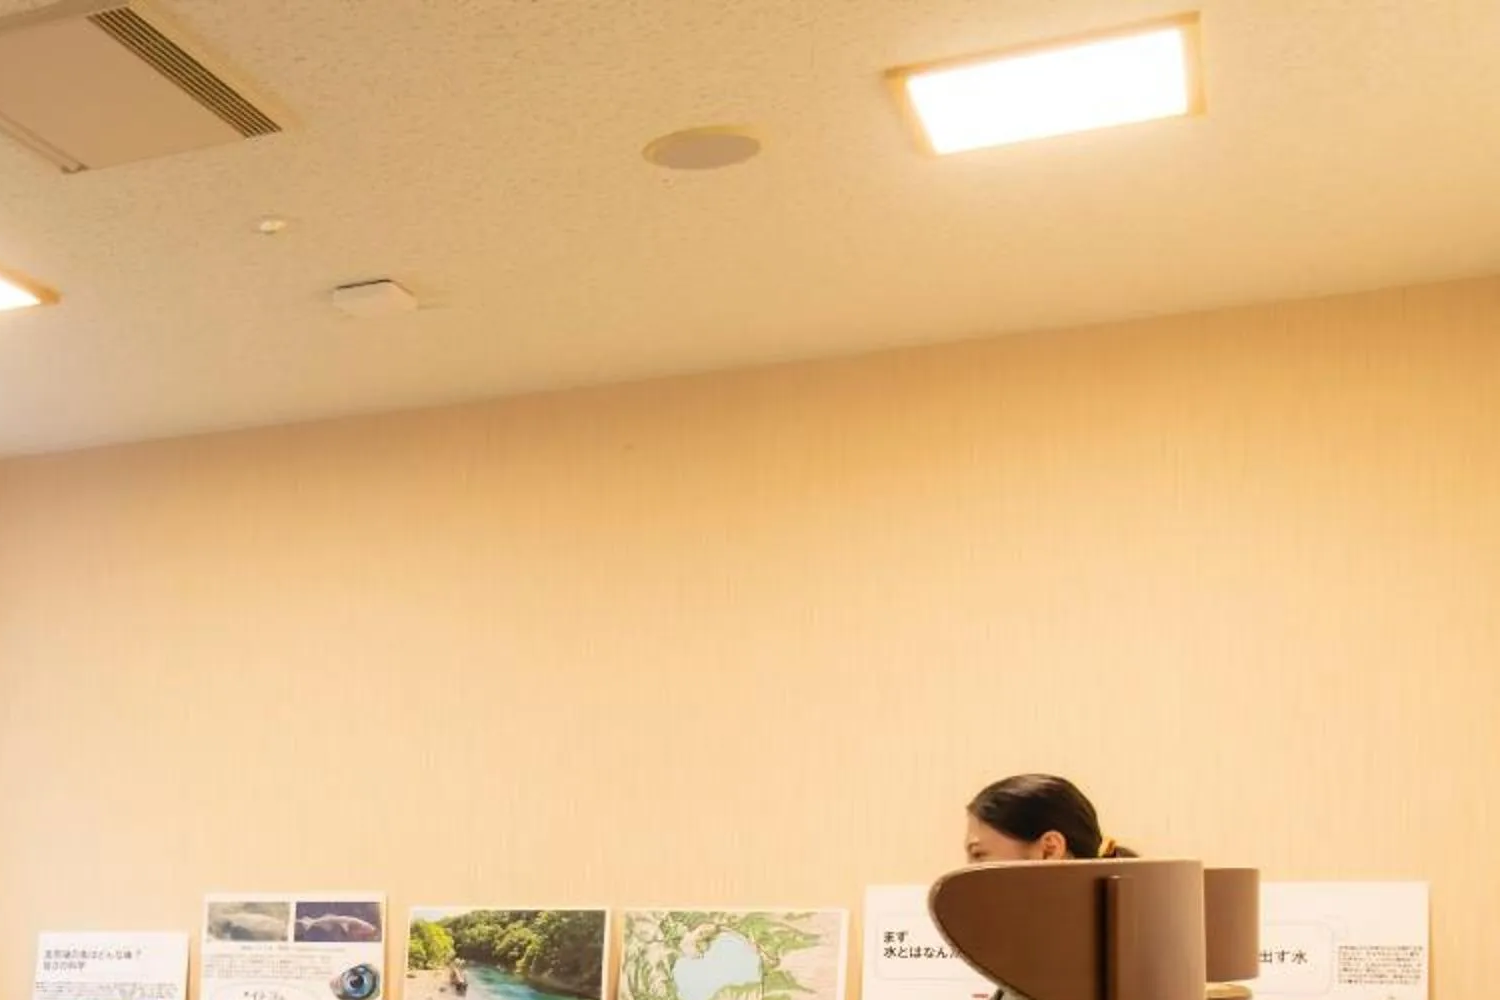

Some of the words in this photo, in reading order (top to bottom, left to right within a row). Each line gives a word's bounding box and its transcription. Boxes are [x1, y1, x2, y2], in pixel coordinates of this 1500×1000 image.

[883, 930, 909, 943] まず
[1259, 949, 1308, 964] 出す水
